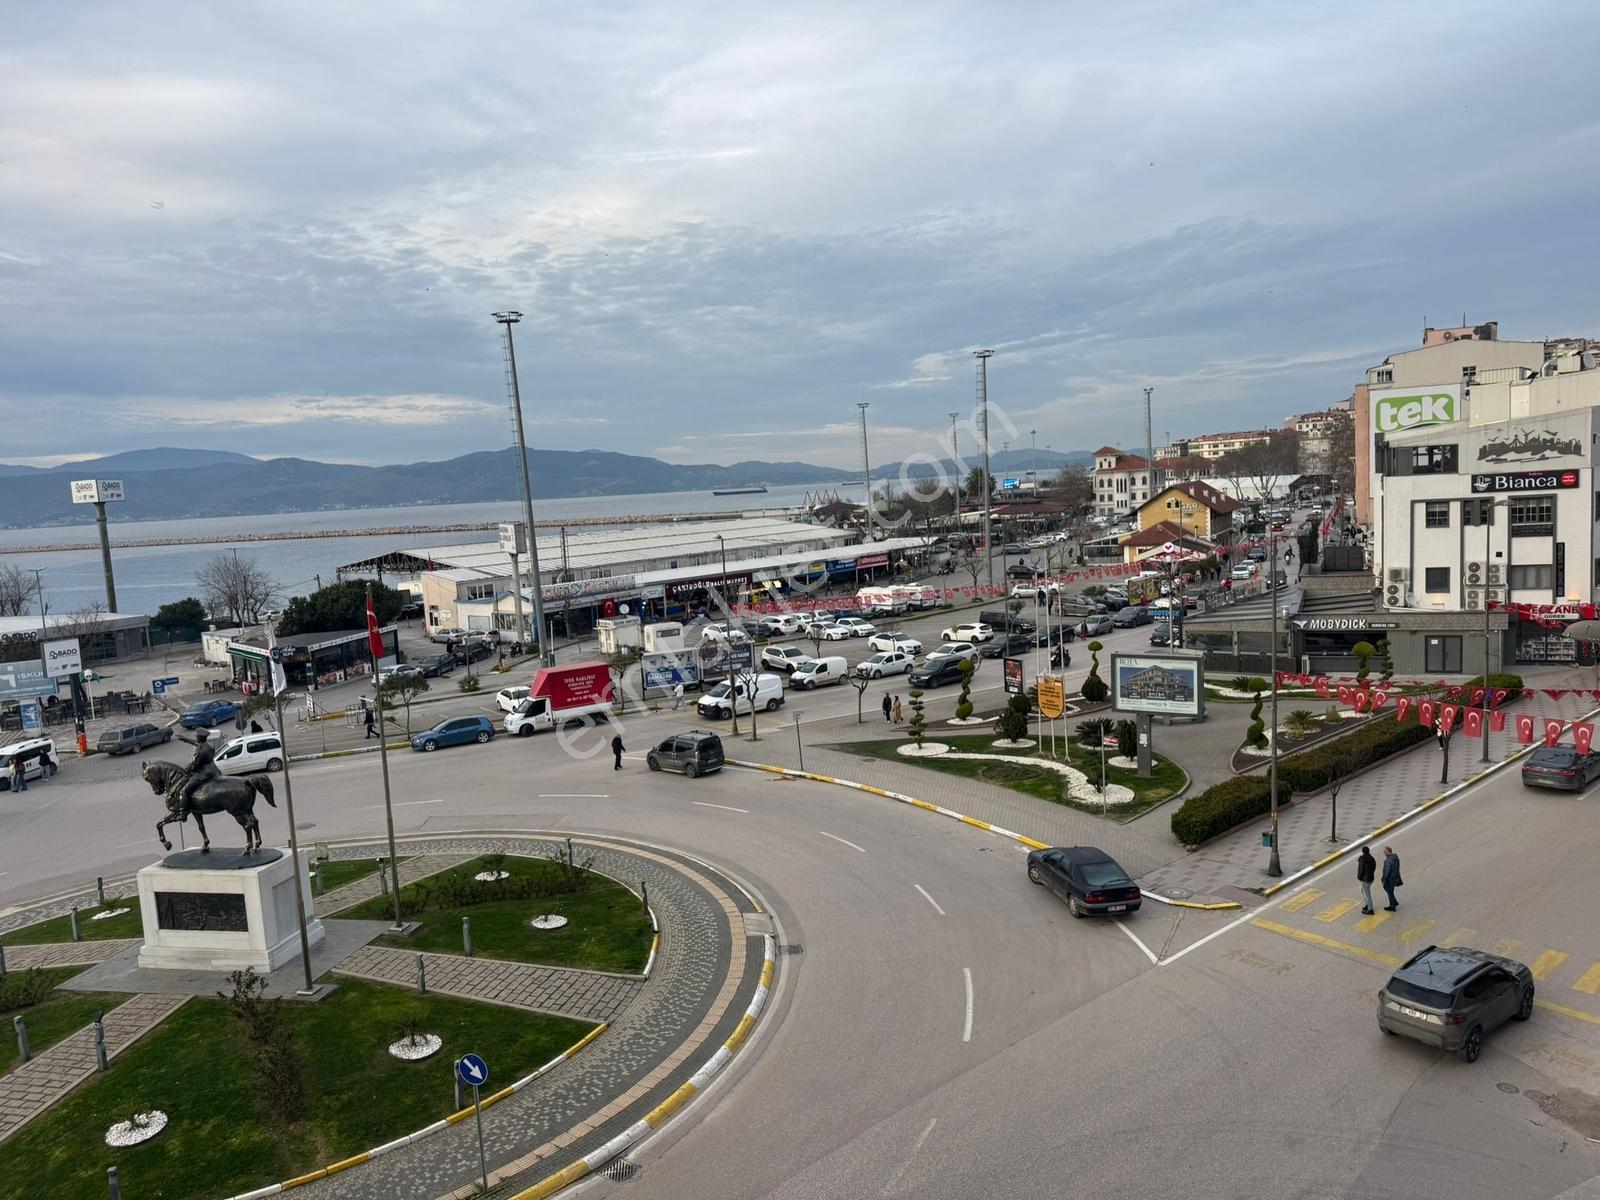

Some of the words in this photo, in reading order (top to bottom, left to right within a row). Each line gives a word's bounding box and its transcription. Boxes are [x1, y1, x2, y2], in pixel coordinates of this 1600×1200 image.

[1380, 396, 1450, 431] tek
[1495, 475, 1557, 490] Bianca
[1147, 609, 1180, 617] MOBYDCK
[1532, 603, 1577, 614] EZANE
[1309, 618, 1366, 629] MOBYDICK
[58, 648, 77, 657] BADO
